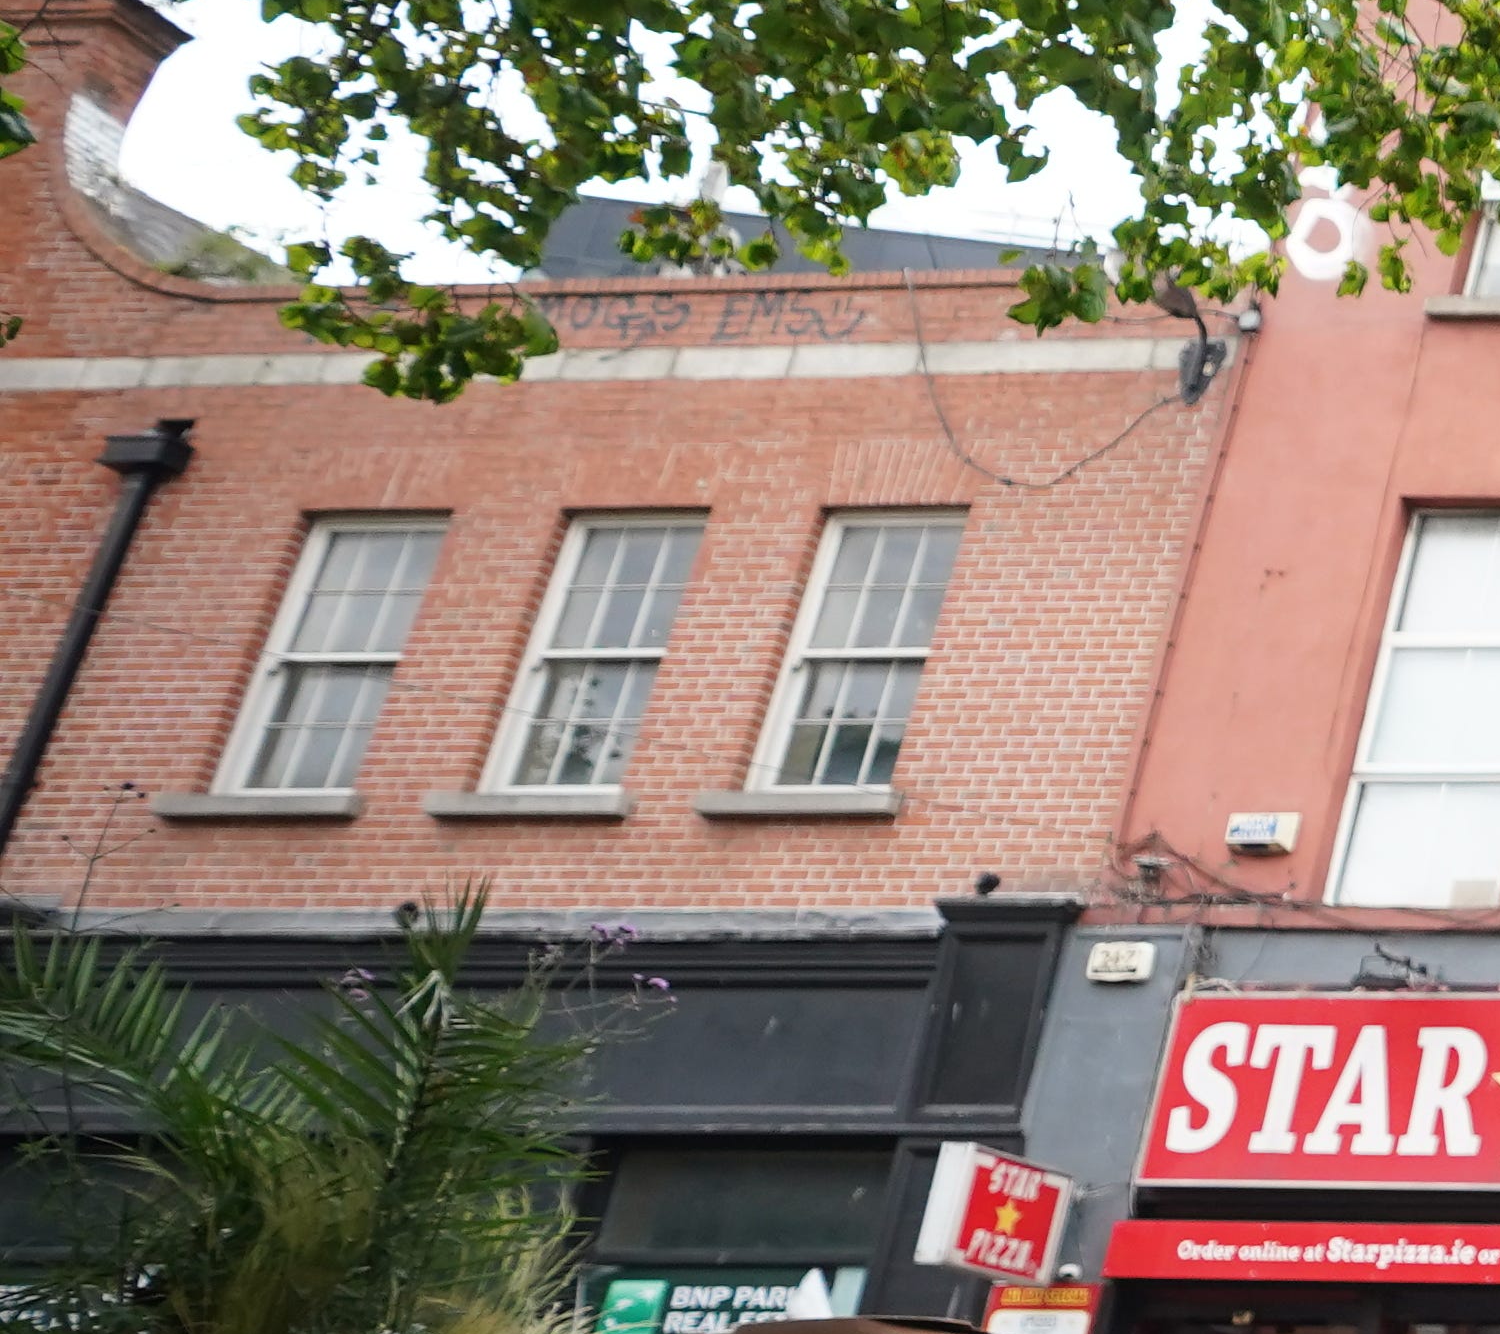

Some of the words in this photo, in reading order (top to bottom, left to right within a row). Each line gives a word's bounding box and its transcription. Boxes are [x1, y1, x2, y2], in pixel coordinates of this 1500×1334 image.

[1165, 1022, 1487, 1156] STAR
[988, 1161, 1042, 1202] STAR
[966, 1228, 1034, 1271] PIZZA
[1177, 1240, 1236, 1261] Order
[1238, 1241, 1301, 1262] online
[1303, 1243, 1325, 1262] at
[1326, 1237, 1477, 1269] Starpizza.ie
[669, 1285, 733, 1309] BNP
